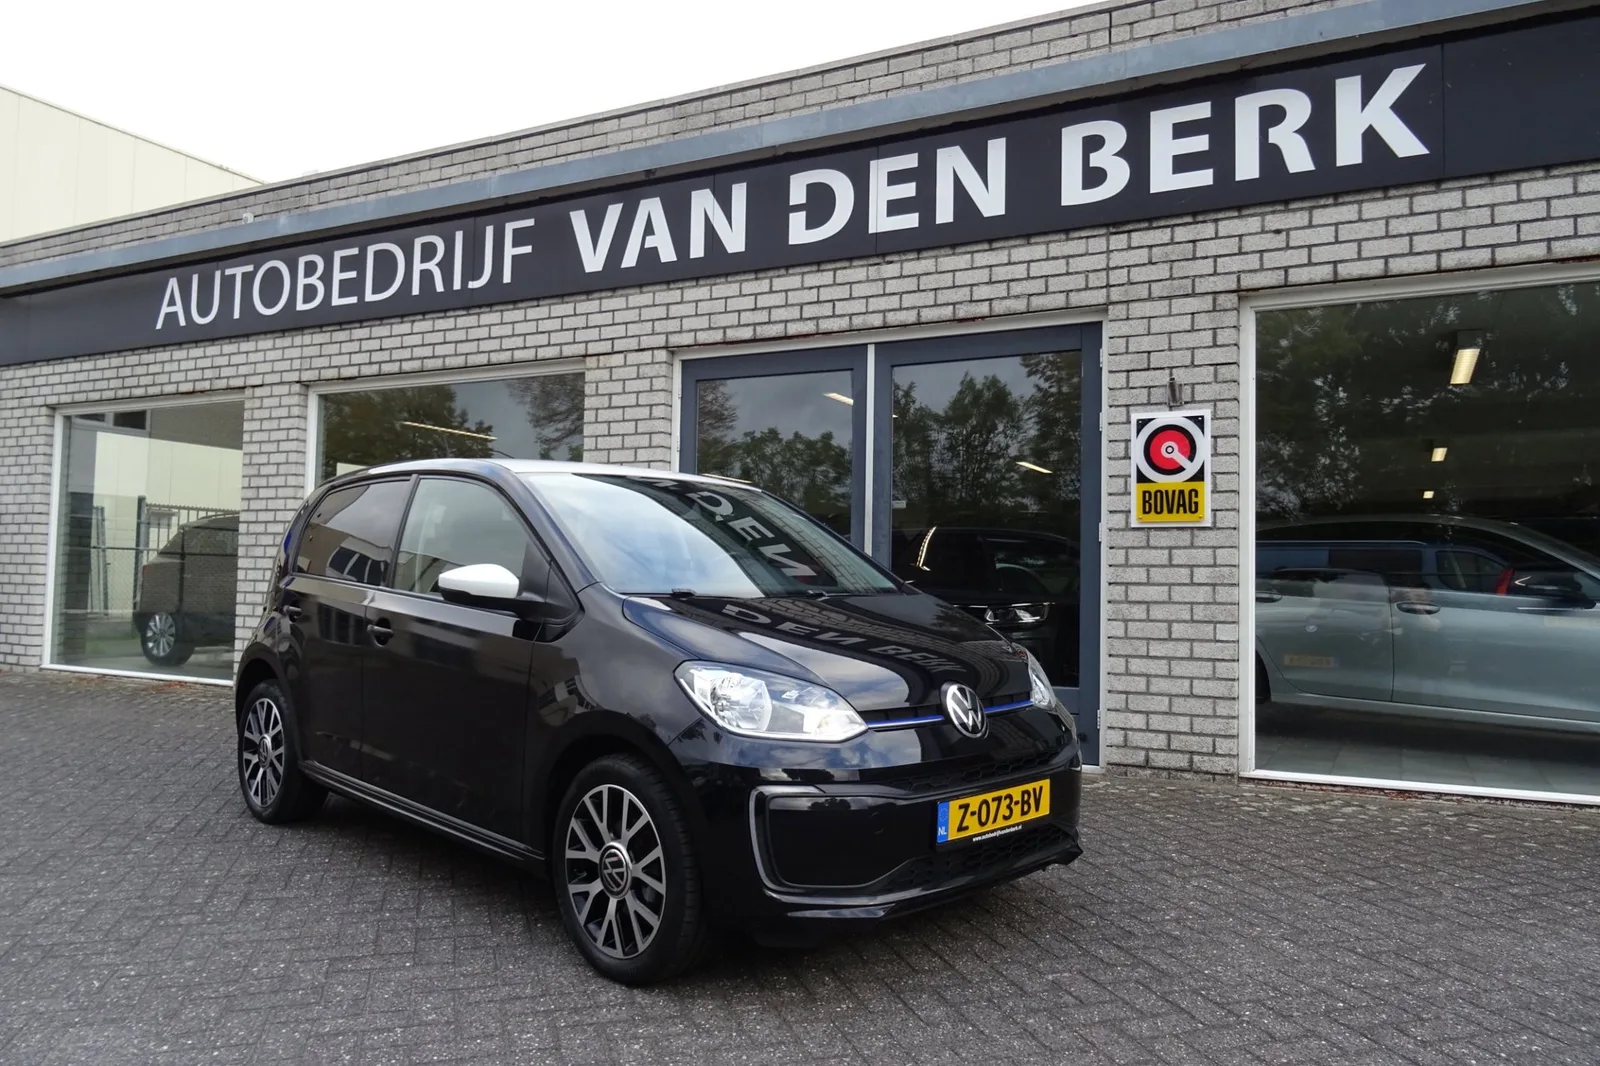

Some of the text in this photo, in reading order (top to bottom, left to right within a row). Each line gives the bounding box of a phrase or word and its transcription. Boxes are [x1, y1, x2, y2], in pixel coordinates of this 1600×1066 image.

[155, 63, 1430, 331] AUTOBEDRIJF VAN DEN BERK
[1142, 488, 1199, 515] BOVAG
[956, 785, 1043, 833] Z-073-BV
